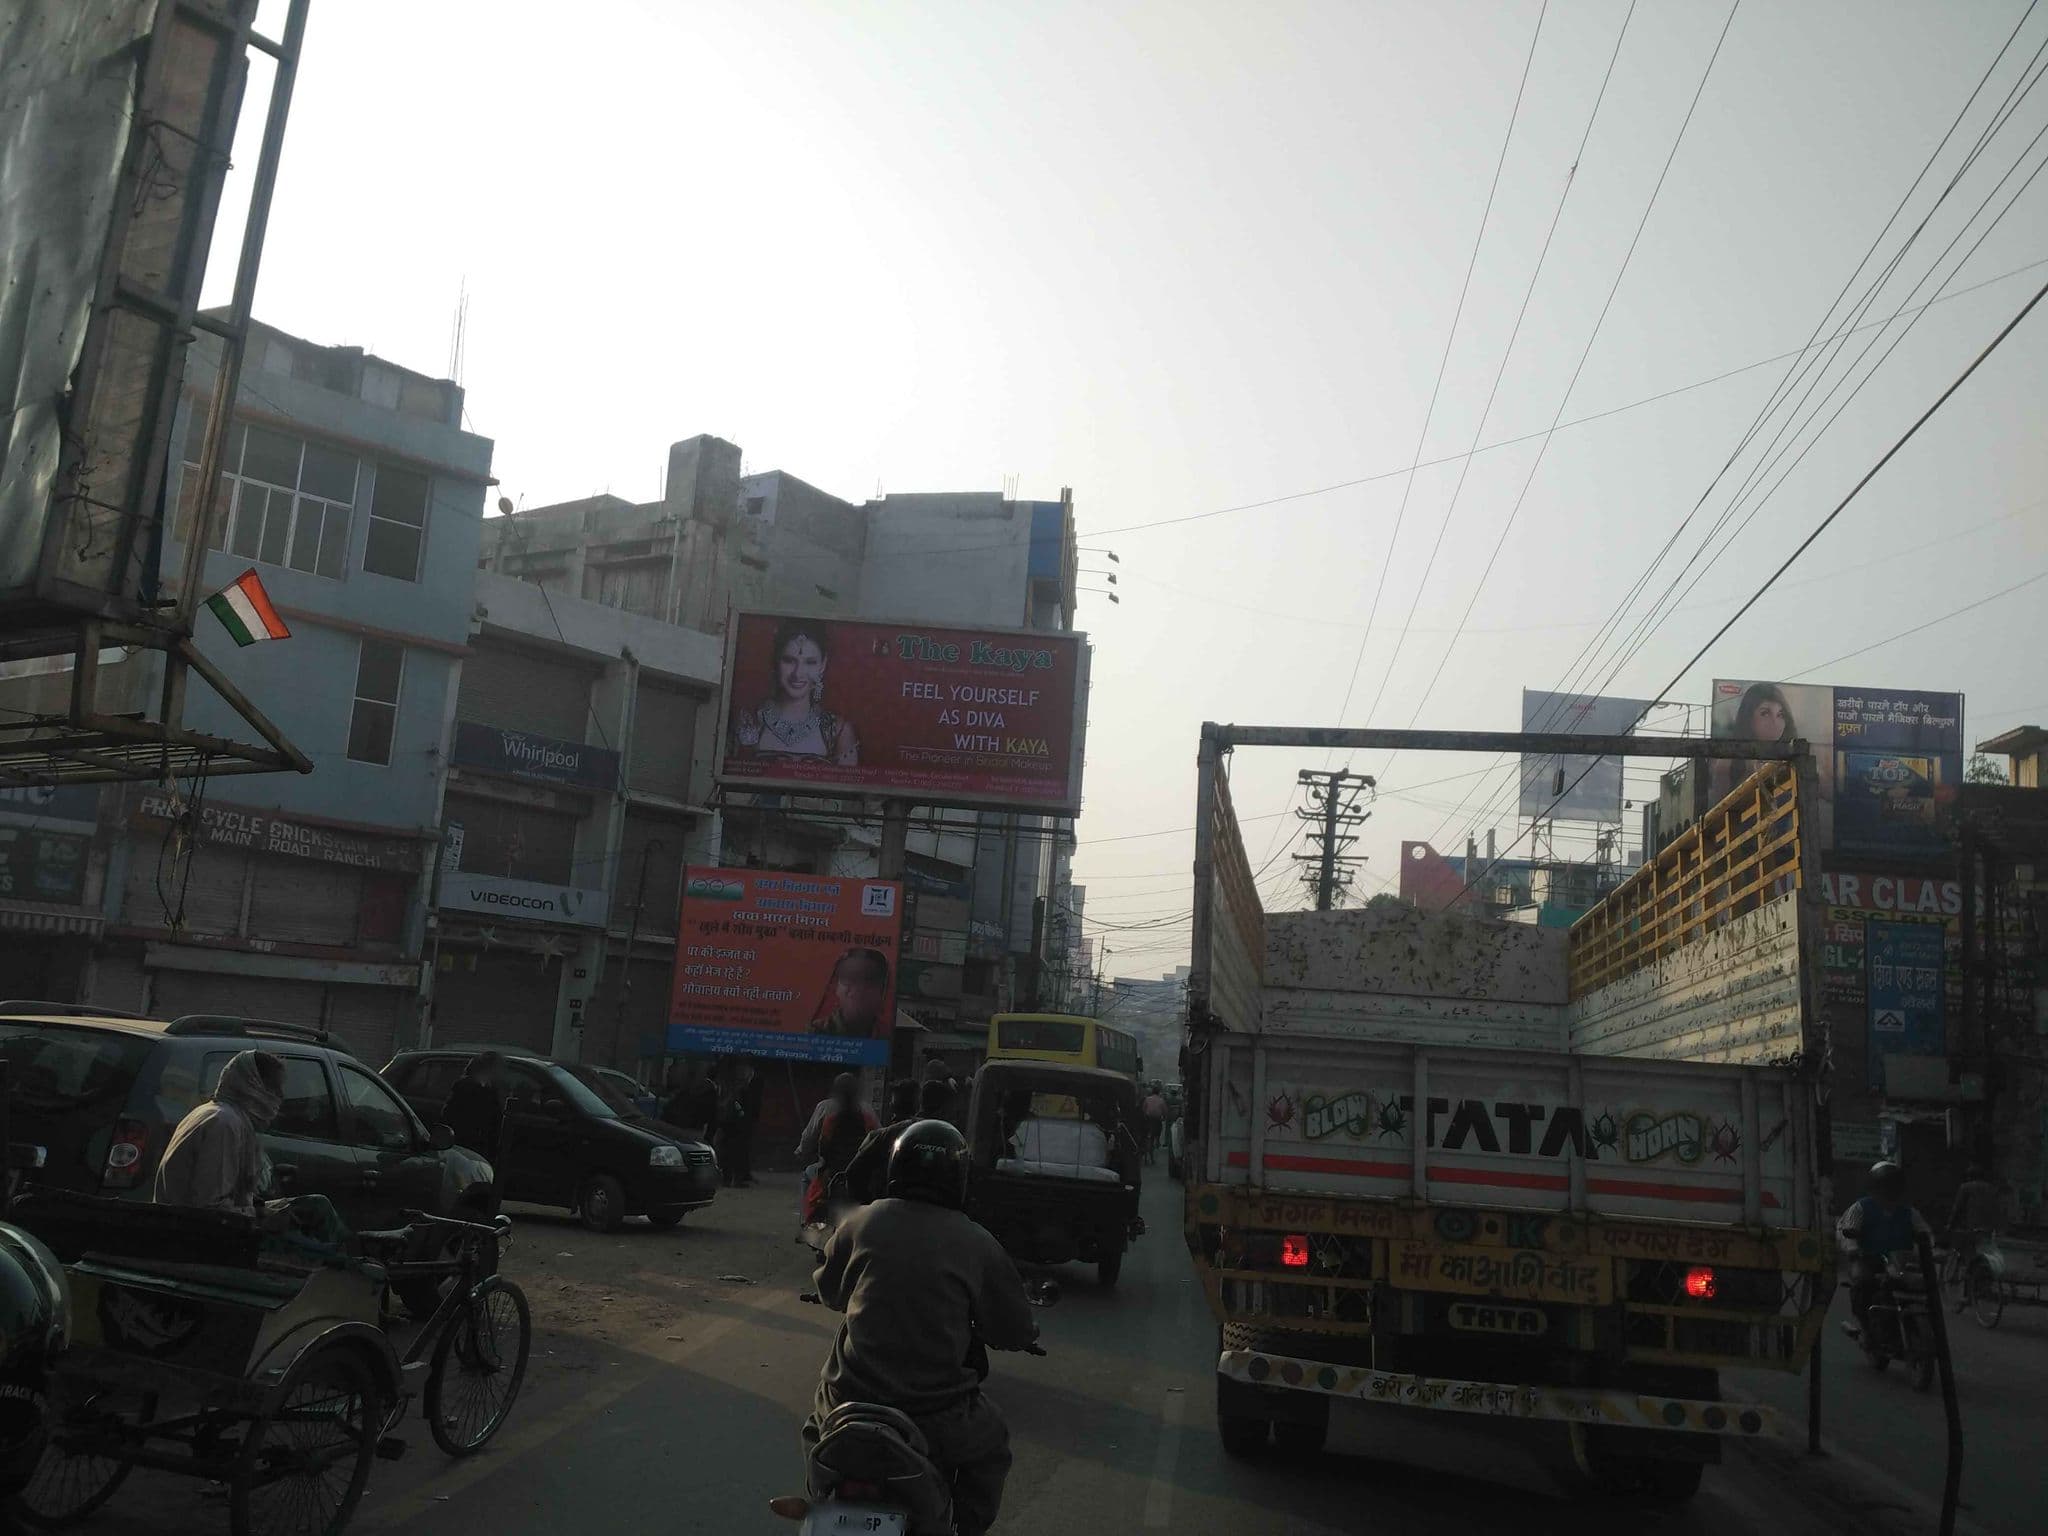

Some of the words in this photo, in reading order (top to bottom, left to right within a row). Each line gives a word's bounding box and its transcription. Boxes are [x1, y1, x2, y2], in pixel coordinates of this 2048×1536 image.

[897, 634, 961, 663] The
[902, 682, 944, 700] FEEL
[950, 684, 1040, 707] YOURSELF
[938, 709, 961, 725] AS
[966, 711, 1006, 728] DIVA
[504, 739, 580, 769] Whirlpool
[954, 735, 1000, 752] WITH
[1005, 737, 1050, 755] KAYA
[1872, 767, 1909, 782] TOP
[200, 807, 264, 836] CYCLE
[210, 827, 253, 847] MAIN
[268, 839, 311, 858] ROAD
[324, 850, 381, 869] RANCHI
[1400, 1098, 1599, 1160] TATA
[1457, 1307, 1537, 1332] TATA
